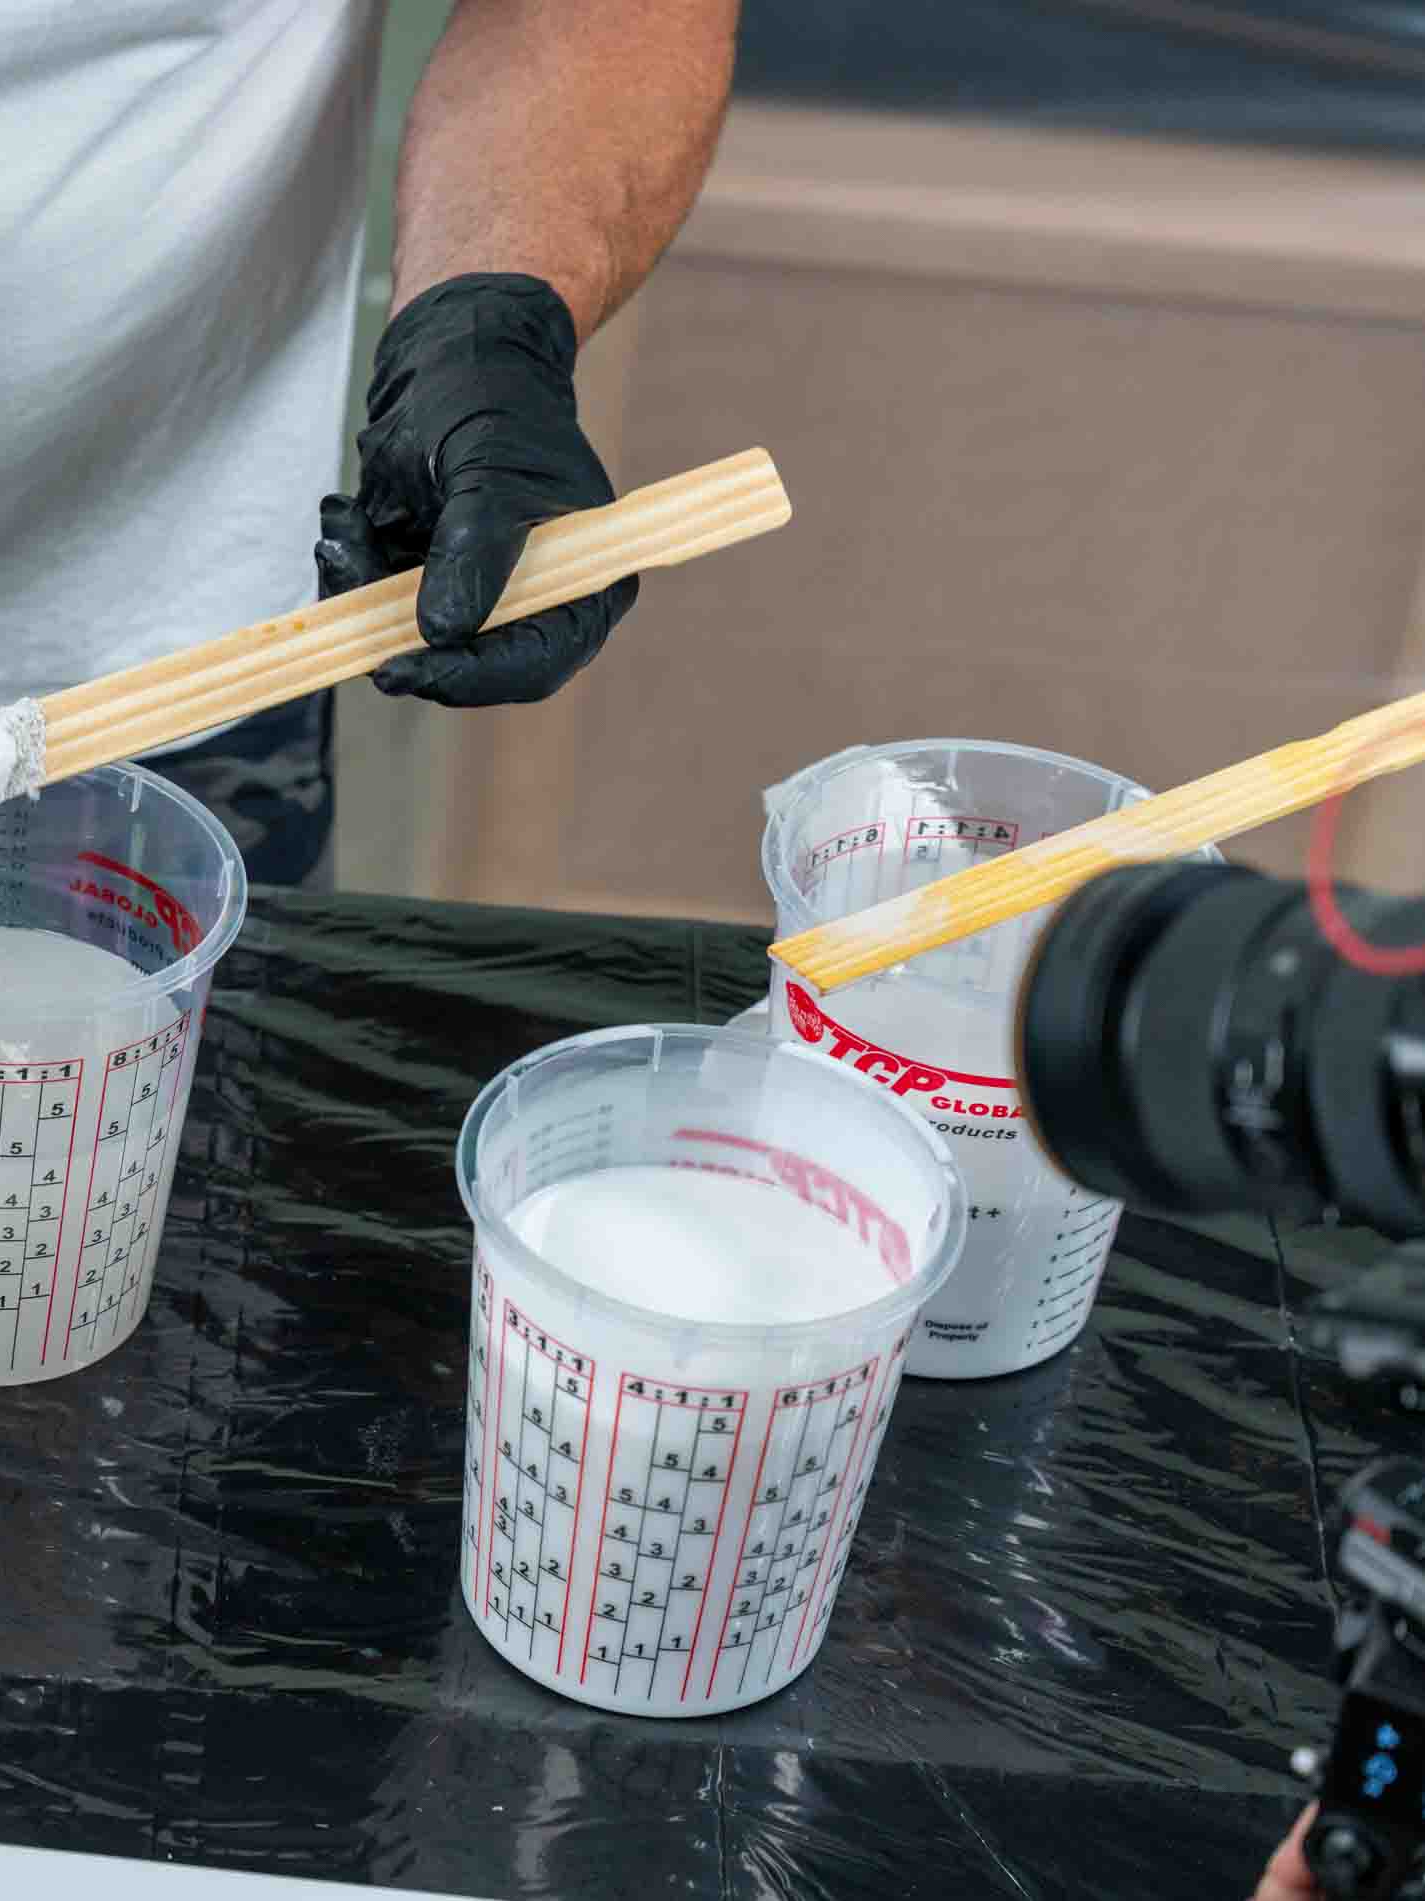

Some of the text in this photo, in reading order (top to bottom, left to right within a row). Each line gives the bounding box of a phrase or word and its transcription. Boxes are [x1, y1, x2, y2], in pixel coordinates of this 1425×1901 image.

[51, 1103, 63, 1116] 5
[931, 1096, 1027, 1119] GLOBA
[108, 1121, 118, 1135] 5
[930, 1120, 1018, 1140] oducts
[10, 1142, 22, 1154] 5
[43, 1169, 56, 1182] 4
[97, 1192, 108, 1203] 4
[40, 1206, 51, 1218] 3
[3, 1227, 14, 1239] 3
[92, 1230, 102, 1242] 3
[36, 1243, 47, 1256] 2
[0, 1260, 11, 1272] 2
[86, 1270, 96, 1283] 2
[32, 1283, 40, 1295] 1
[713, 1418, 726, 1433] 5
[666, 1454, 678, 1469] 5
[704, 1466, 716, 1478] 4
[620, 1488, 632, 1504] 5
[658, 1498, 670, 1512] 4
[614, 1526, 626, 1538] 4
[694, 1520, 705, 1531] 3
[651, 1543, 662, 1556] 3
[609, 1563, 621, 1579] 3
[683, 1576, 695, 1588] 2
[642, 1592, 654, 1605] 2
[603, 1604, 615, 1617] 2
[672, 1637, 681, 1648] 1
